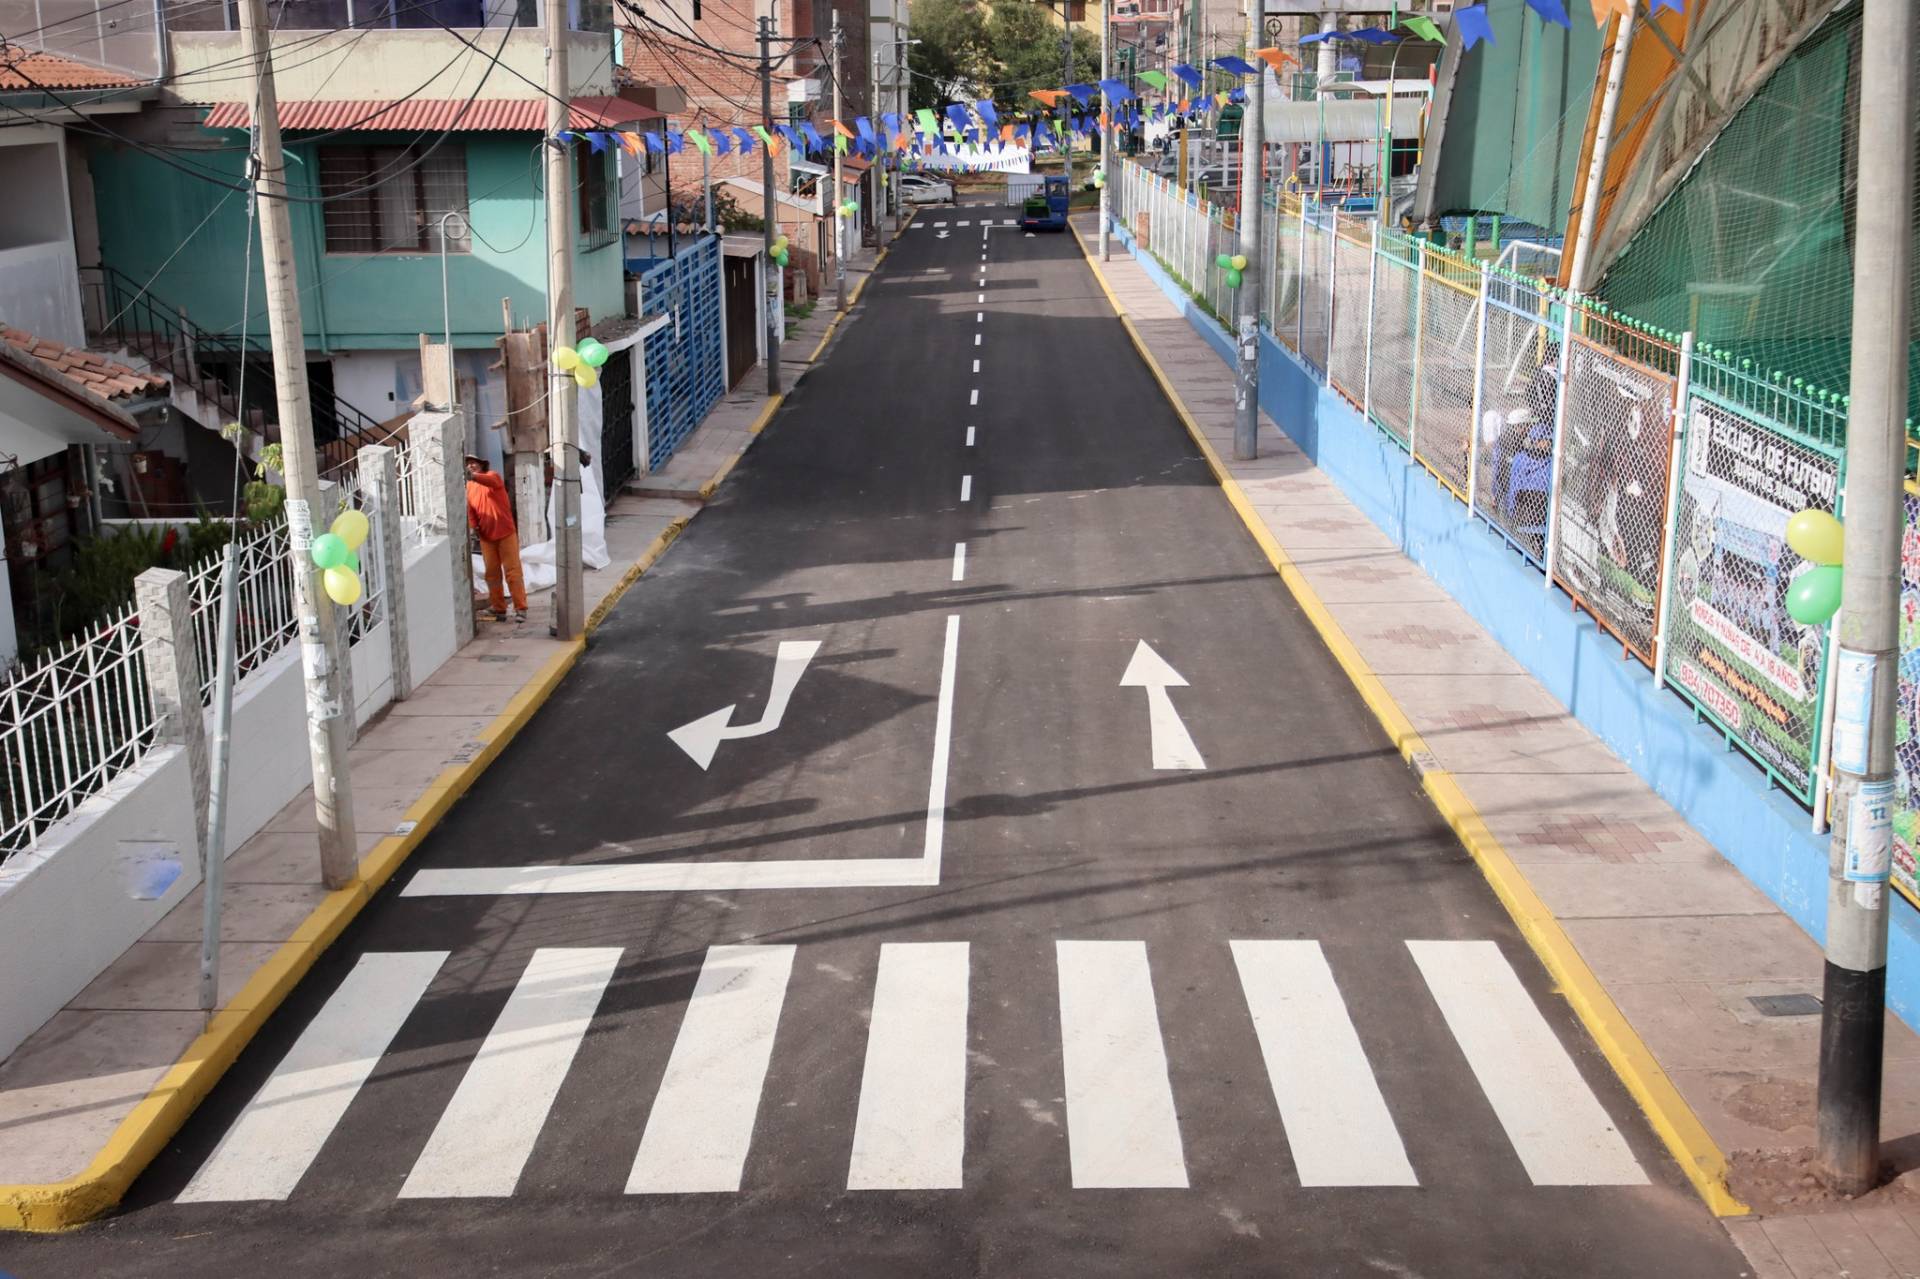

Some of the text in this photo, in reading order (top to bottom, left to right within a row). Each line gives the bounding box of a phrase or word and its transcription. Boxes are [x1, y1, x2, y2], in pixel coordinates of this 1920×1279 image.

[1712, 418, 1764, 462] ESCUELA
[1766, 445, 1783, 475] DE
[1733, 459, 1807, 509] JUVENTUS JUNIOR
[1740, 638, 1751, 657] DE
[1767, 657, 1775, 675] 18
[1776, 664, 1799, 691] AÑOS
